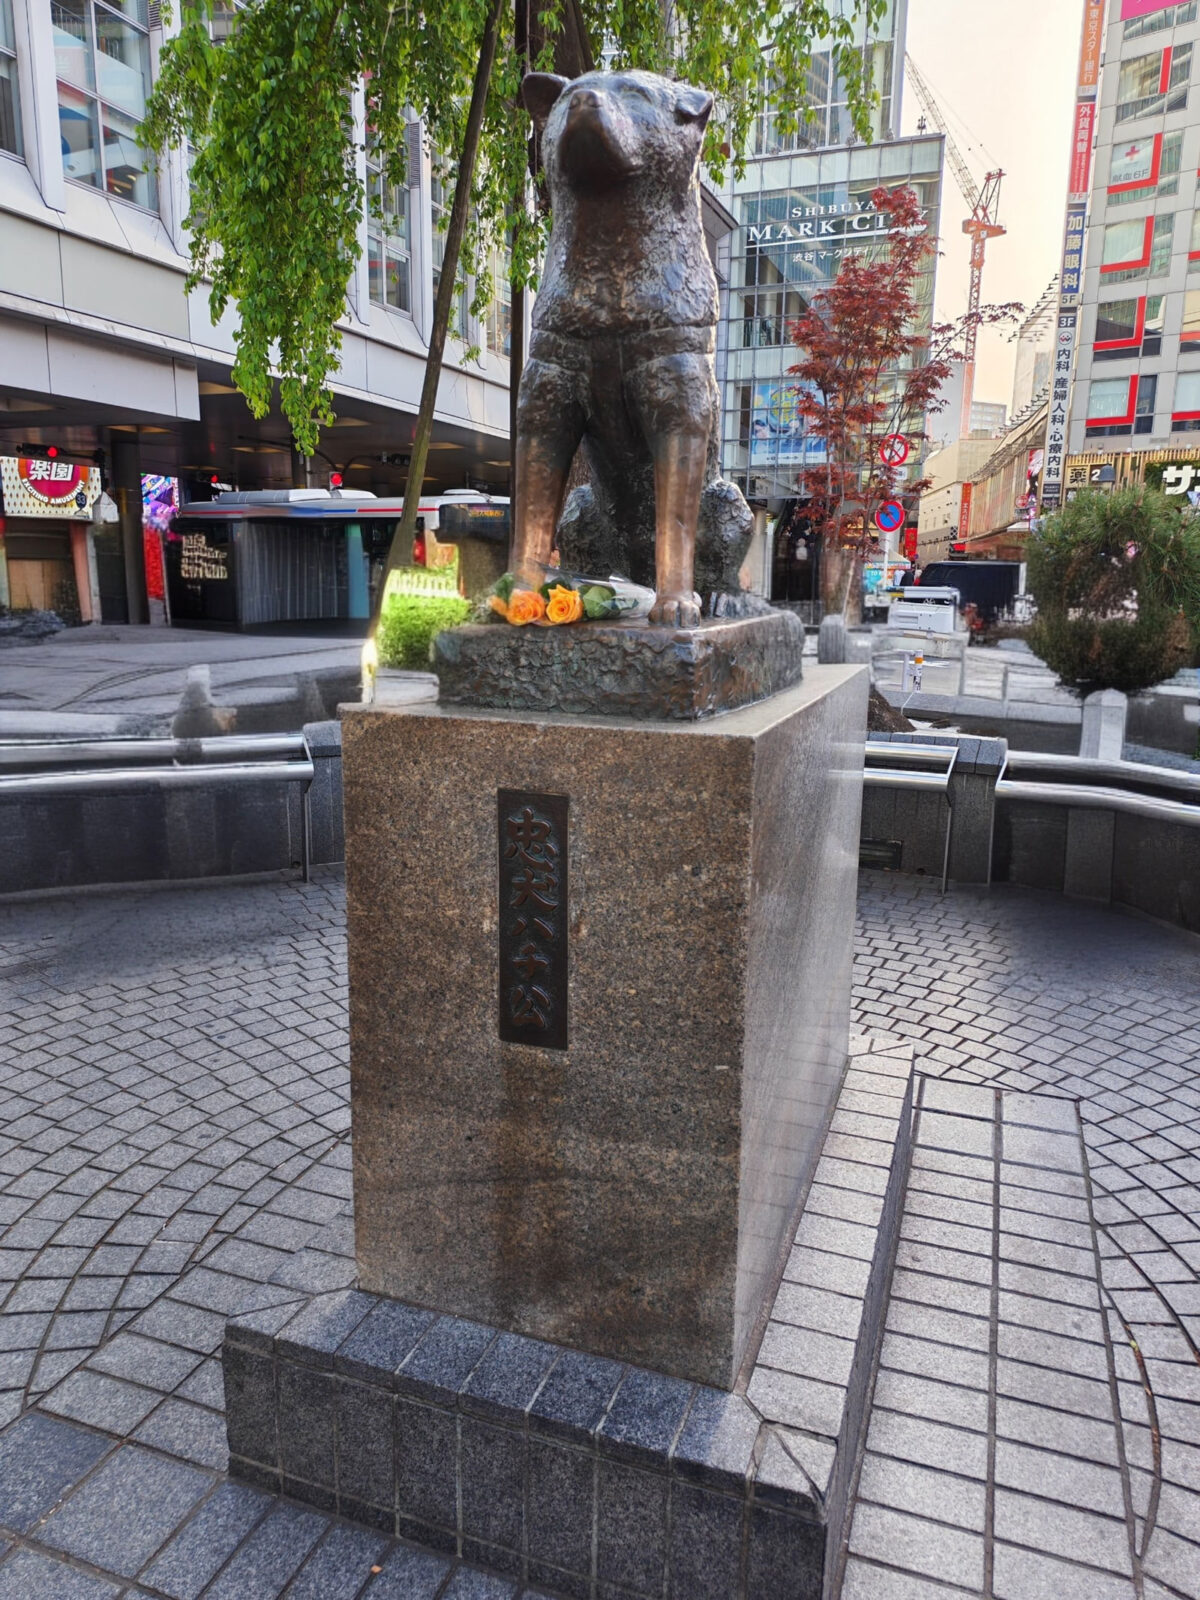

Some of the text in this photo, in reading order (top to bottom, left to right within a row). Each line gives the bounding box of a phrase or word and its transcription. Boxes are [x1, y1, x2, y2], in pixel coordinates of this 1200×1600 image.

[1084, 9, 1100, 83] 東京スター銀行
[1077, 105, 1091, 153] 外貨両替
[791, 200, 876, 218] SHIBUYA
[748, 210, 929, 242] MARK CI
[792, 251, 814, 262] 渋谷
[1063, 215, 1084, 289] 加藤眼科
[1061, 294, 1077, 304] 5F
[1060, 317, 1075, 327] 3F
[1056, 348, 1071, 372] 内科
[29, 460, 74, 481] 楽園
[1069, 467, 1087, 484] 薬
[1162, 465, 1200, 495] サ
[22, 478, 85, 504] EXCITING AMUSEMENT
